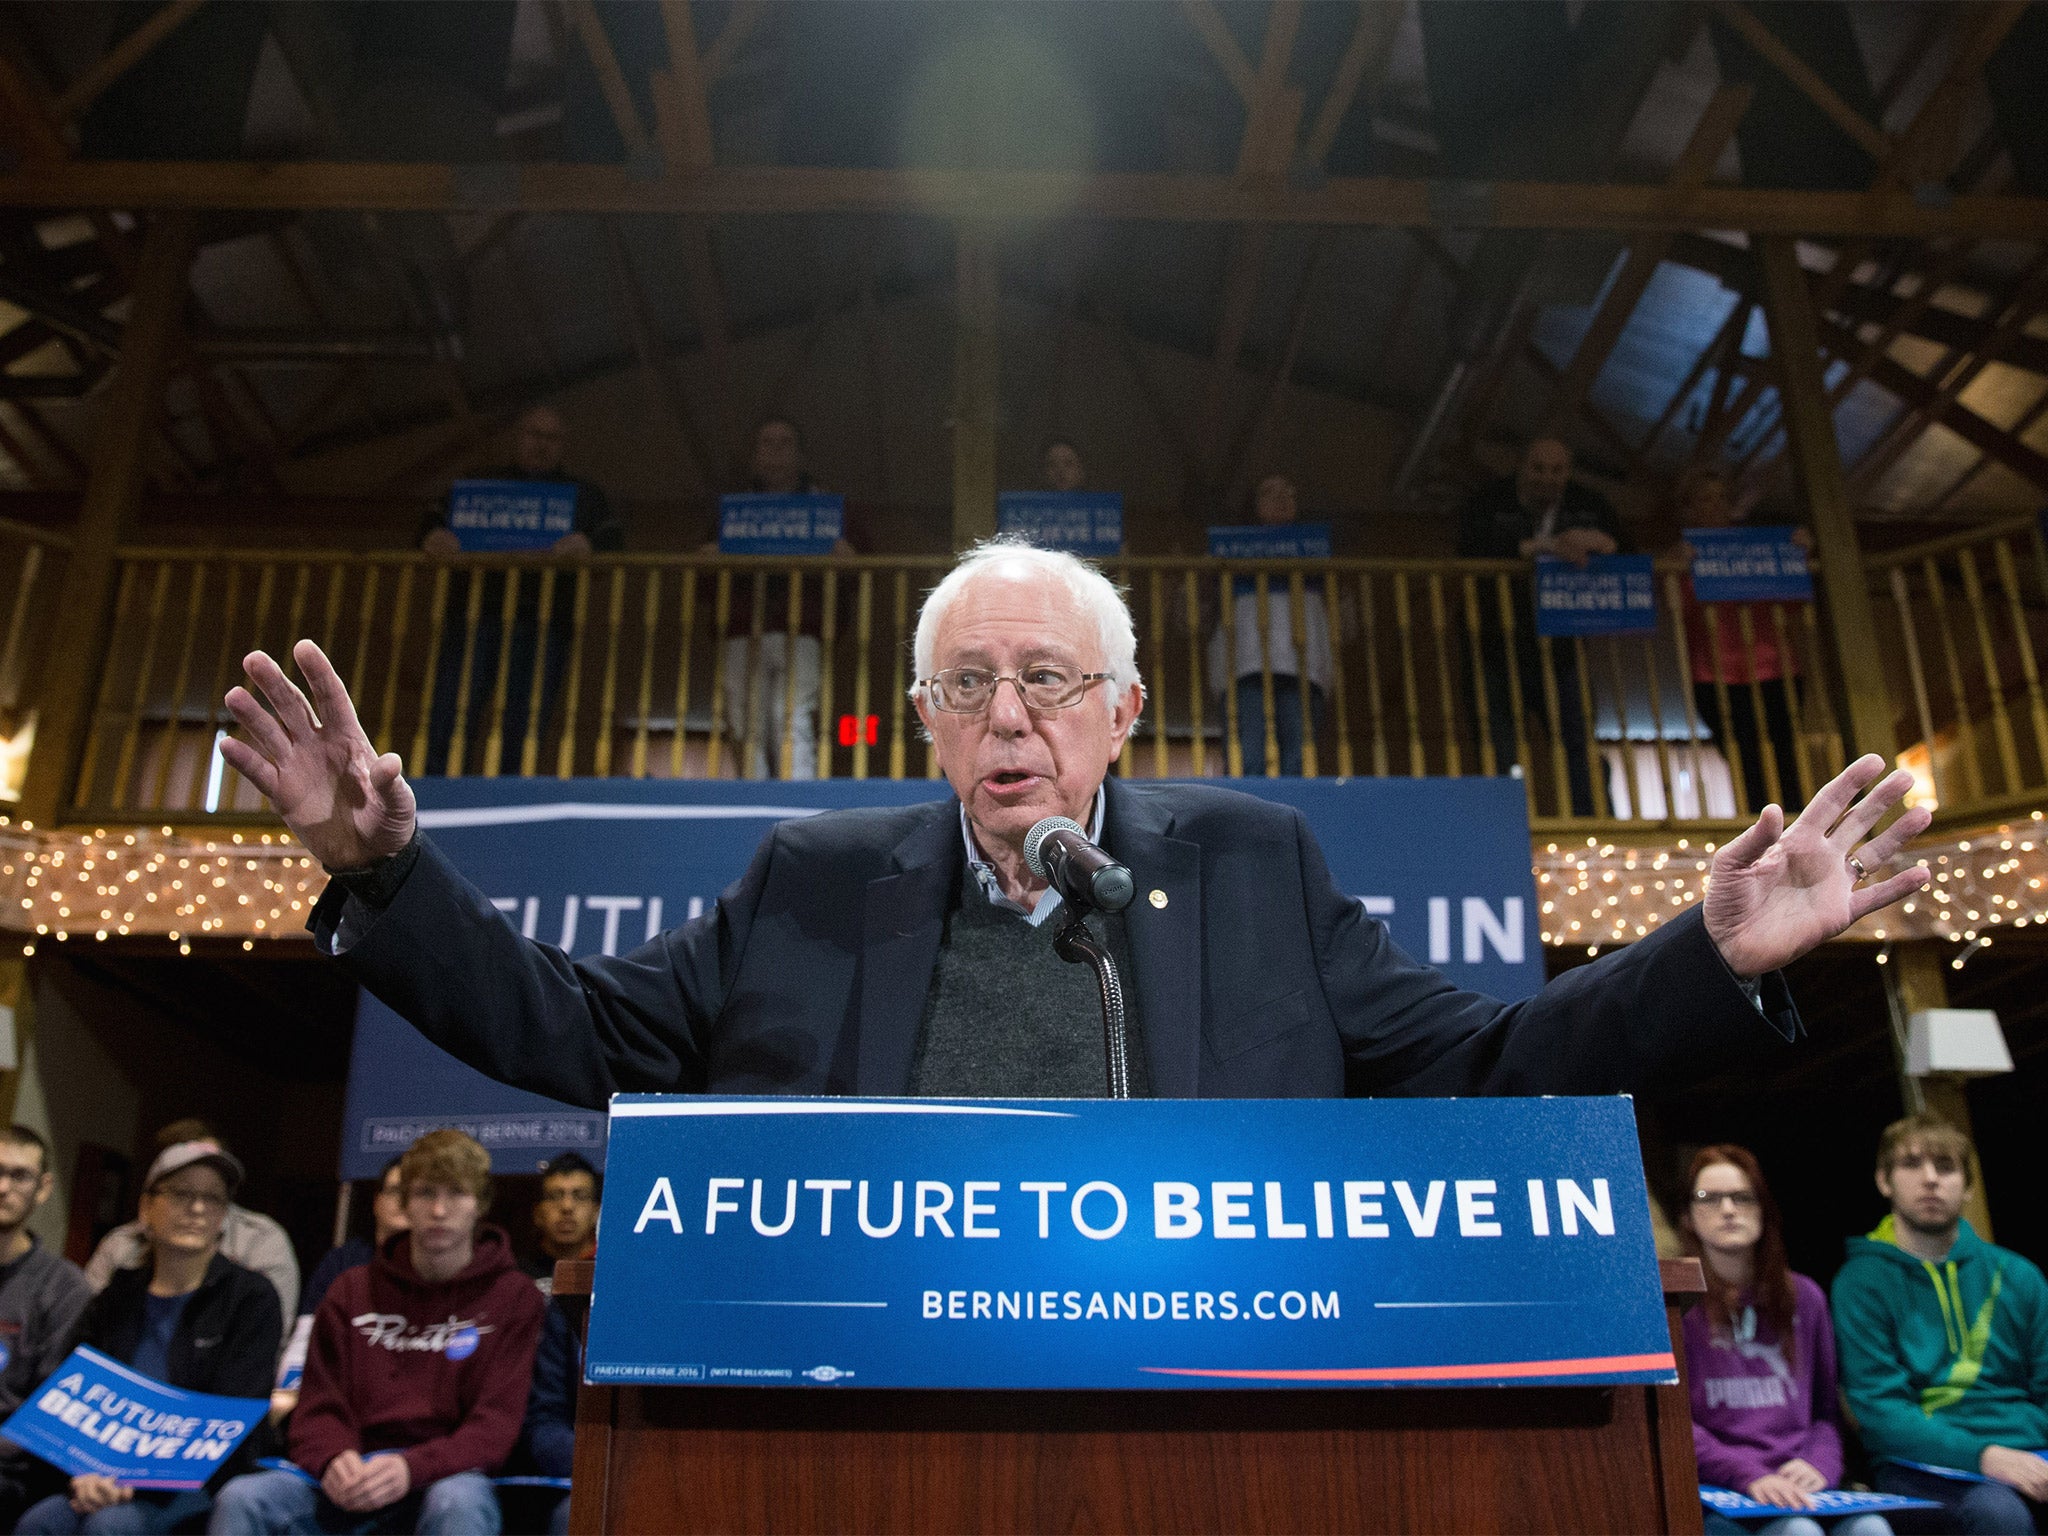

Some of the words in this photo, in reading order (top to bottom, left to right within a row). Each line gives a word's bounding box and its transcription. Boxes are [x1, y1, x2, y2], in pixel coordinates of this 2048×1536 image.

[453, 512, 541, 530] BELIEVE
[544, 515, 571, 531] IN
[722, 523, 810, 539] BELIEVE
[814, 524, 841, 539] IN
[1095, 527, 1122, 542] IN
[1693, 560, 1777, 577] BELIEVE
[1781, 560, 1807, 576] IN
[1540, 591, 1622, 610] BELIEVE
[1626, 591, 1653, 609] IN
[1428, 897, 1524, 963] IN
[633, 1177, 683, 1234] A
[705, 1178, 1000, 1239] FUTURE
[1019, 1181, 1128, 1240] TO
[1153, 1179, 1502, 1239] BELIEVE
[1527, 1178, 1616, 1237] IN
[922, 1290, 1340, 1320] BERNIESANDERS.COM
[594, 1365, 615, 1376] PAID
[615, 1366, 633, 1376] FOR
[646, 1366, 676, 1377] BERNIE
[677, 1366, 699, 1377] 2016
[57, 1371, 85, 1396] A
[82, 1383, 202, 1437] FUTURE
[203, 1418, 246, 1441] TO
[37, 1387, 188, 1459] BELIEVE
[182, 1438, 232, 1462] IN
